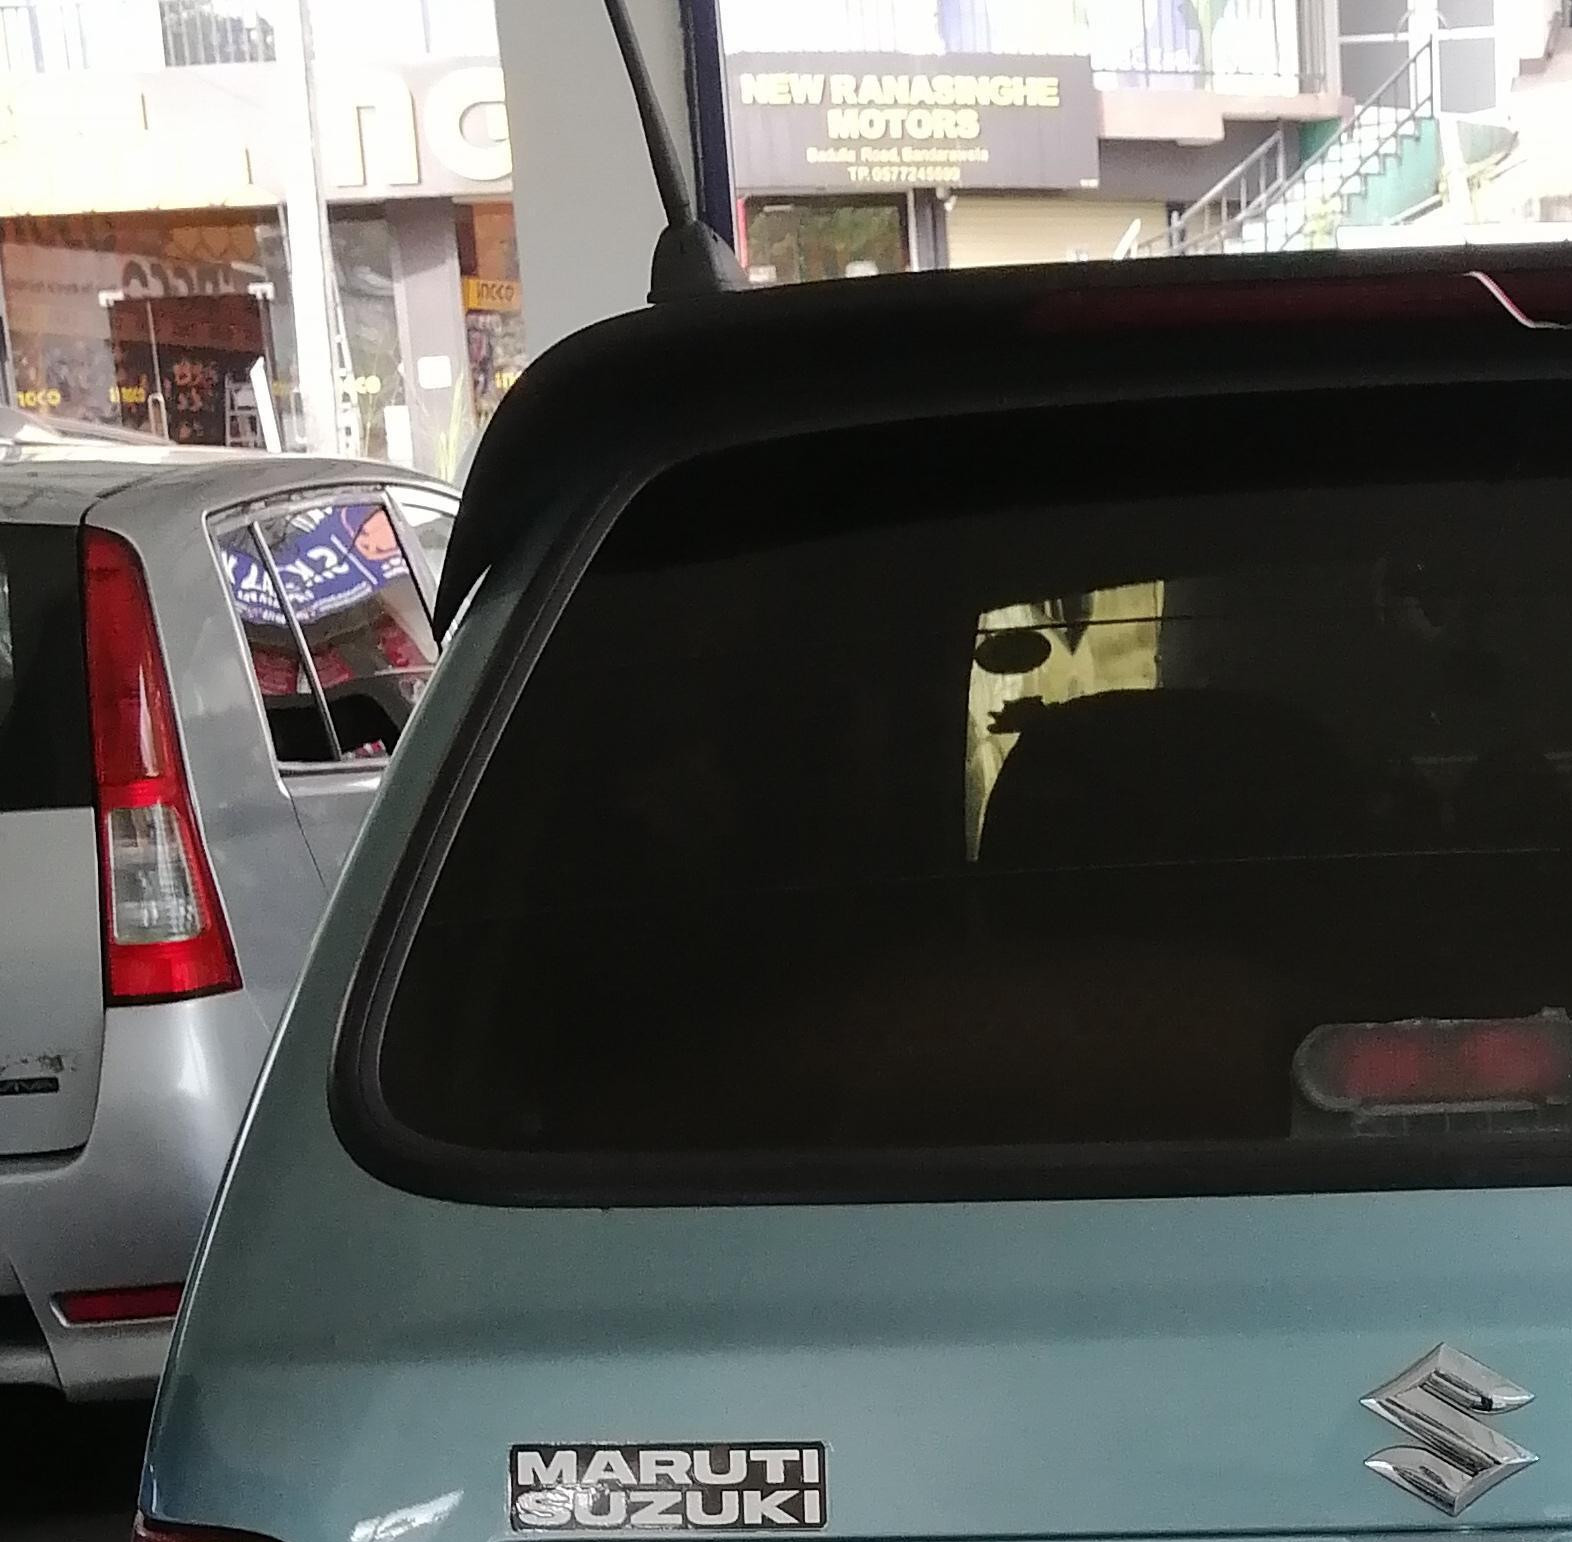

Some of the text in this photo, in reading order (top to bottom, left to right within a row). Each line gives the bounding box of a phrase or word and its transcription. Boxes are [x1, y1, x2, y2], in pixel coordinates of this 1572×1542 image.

[740, 73, 1060, 107] NEW RANASINGHE
[827, 108, 980, 139] MOTORS
[516, 1448, 820, 1487] MARUTI
[515, 1489, 822, 1527] SUZUKI
